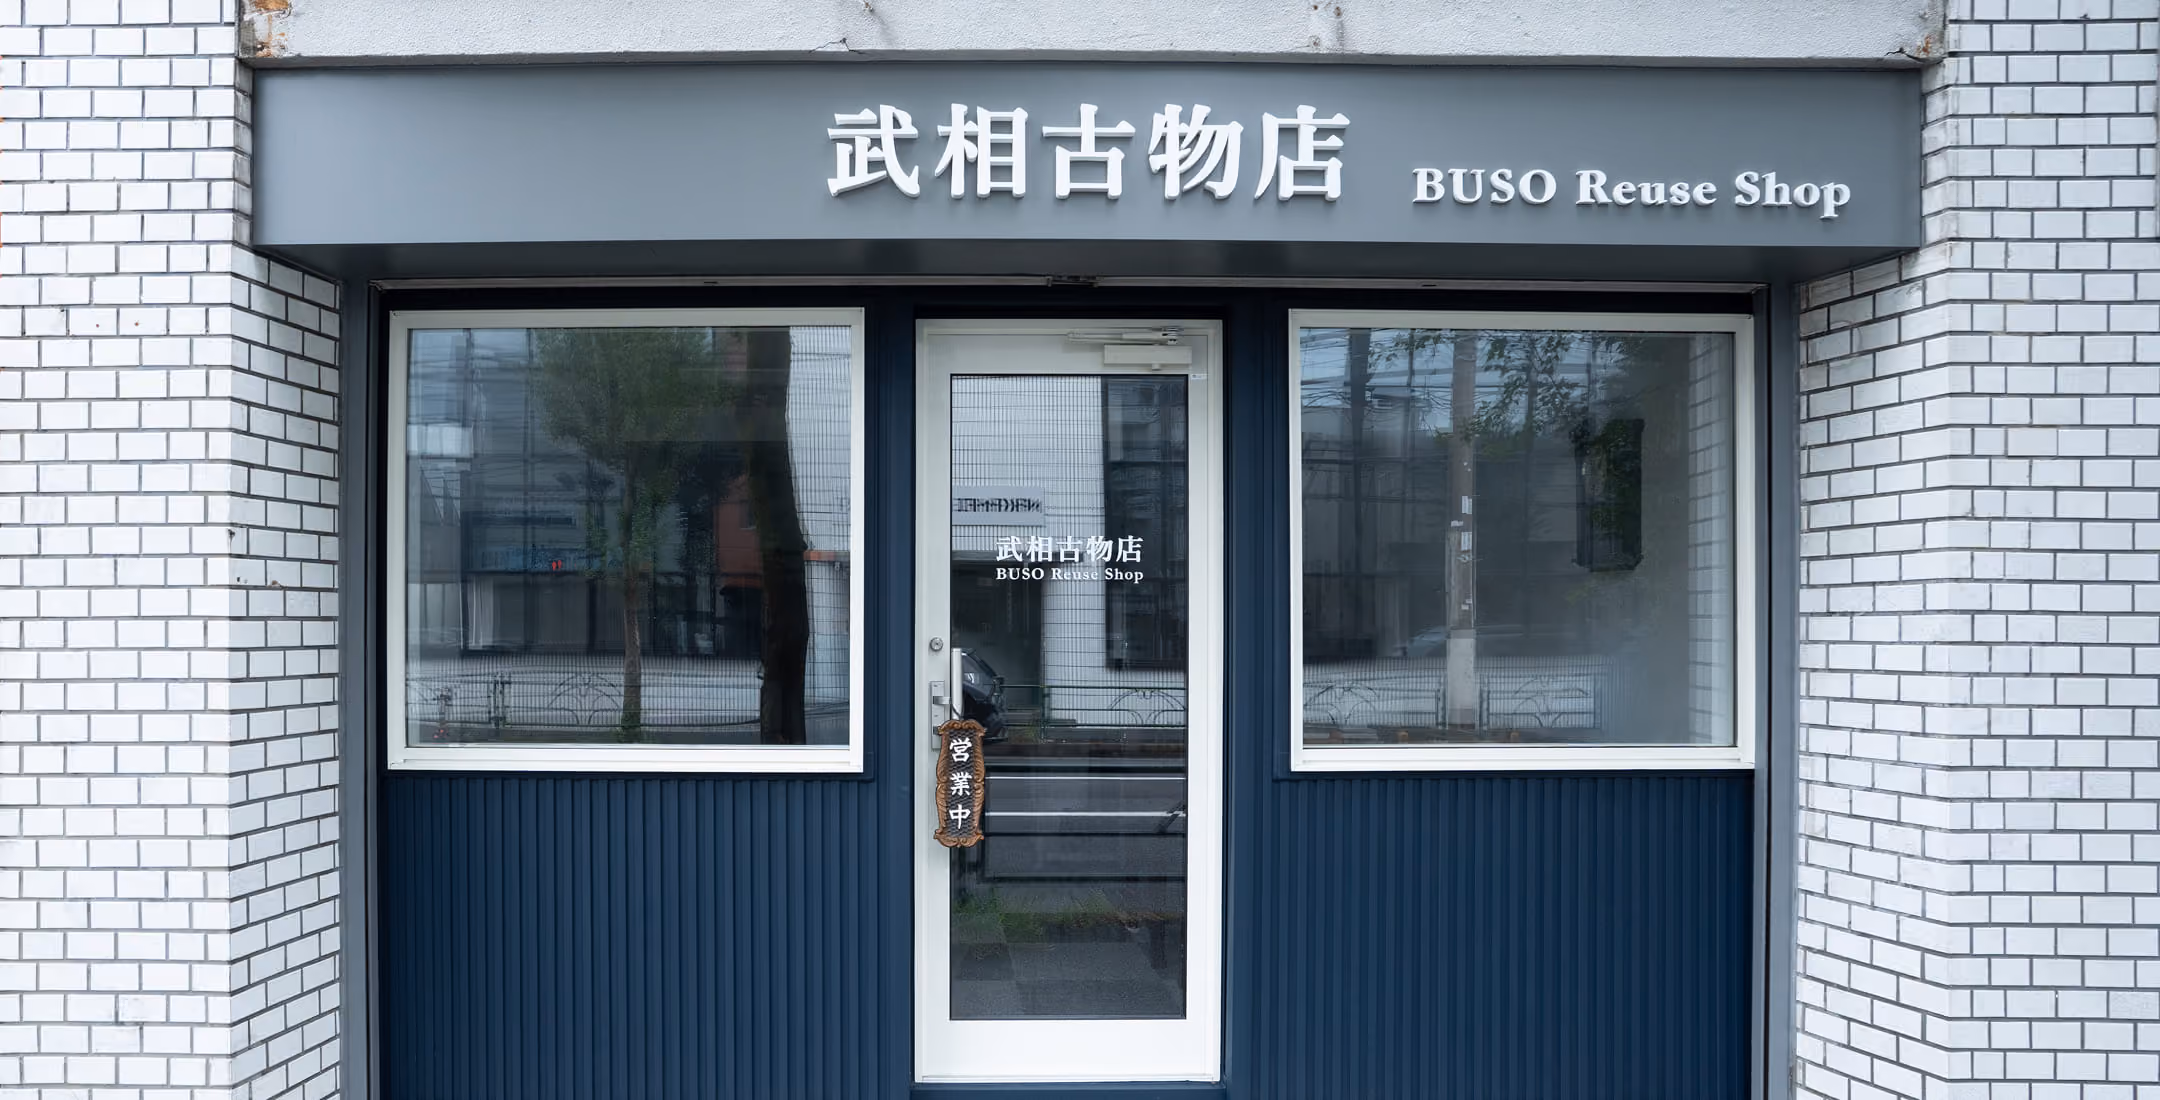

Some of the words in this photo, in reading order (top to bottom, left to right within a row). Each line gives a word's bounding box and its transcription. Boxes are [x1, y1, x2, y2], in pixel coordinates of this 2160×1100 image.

[826, 102, 1351, 201] 武相古物店
[1412, 167, 1557, 206] BUSO
[1575, 169, 1717, 208] Reuse
[1734, 171, 1851, 219] Shop
[996, 535, 1144, 563] 武相古物店
[996, 567, 1045, 580] BUSO
[1051, 567, 1099, 580] Reuse
[1104, 567, 1144, 584] Shop
[948, 737, 973, 830] 営業中
